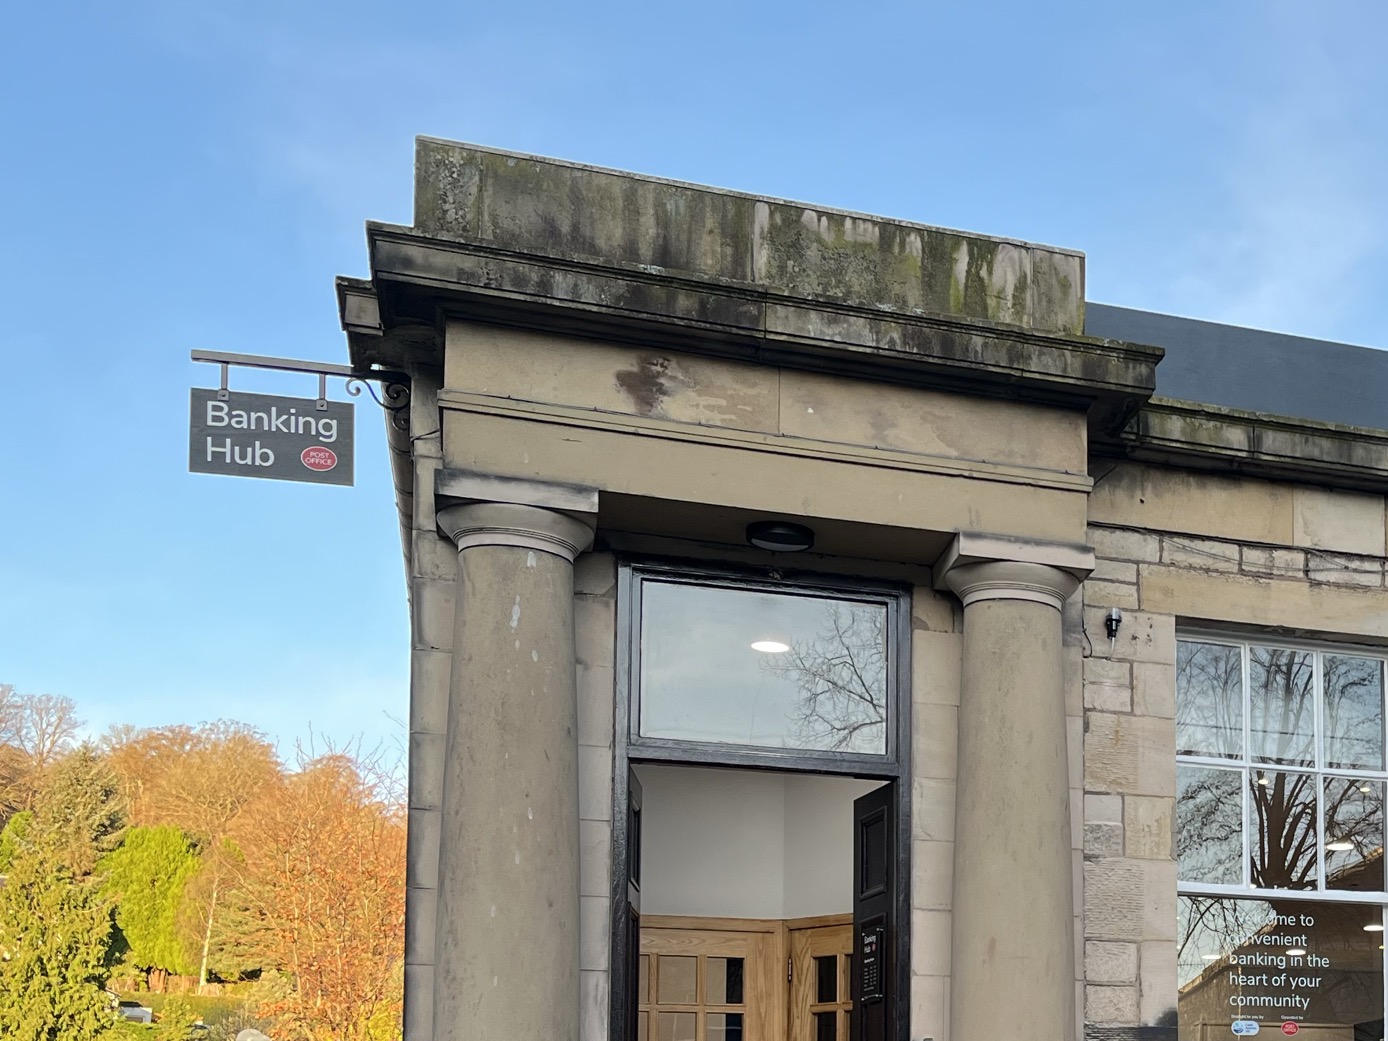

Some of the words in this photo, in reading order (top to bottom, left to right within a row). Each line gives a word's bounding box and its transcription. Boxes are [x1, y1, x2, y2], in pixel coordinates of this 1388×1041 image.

[206, 400, 338, 443] Banking
[206, 436, 275, 467] Hub
[304, 457, 332, 465] OFFICE
[1300, 914, 1314, 926] to
[1229, 932, 1308, 946] convenient
[1229, 952, 1285, 969] banking
[1290, 954, 1302, 967] in
[1307, 954, 1330, 968] the
[1229, 972, 1268, 986] heart
[1271, 973, 1286, 987] of
[1289, 976, 1322, 990] your
[1229, 994, 1310, 1010] community
